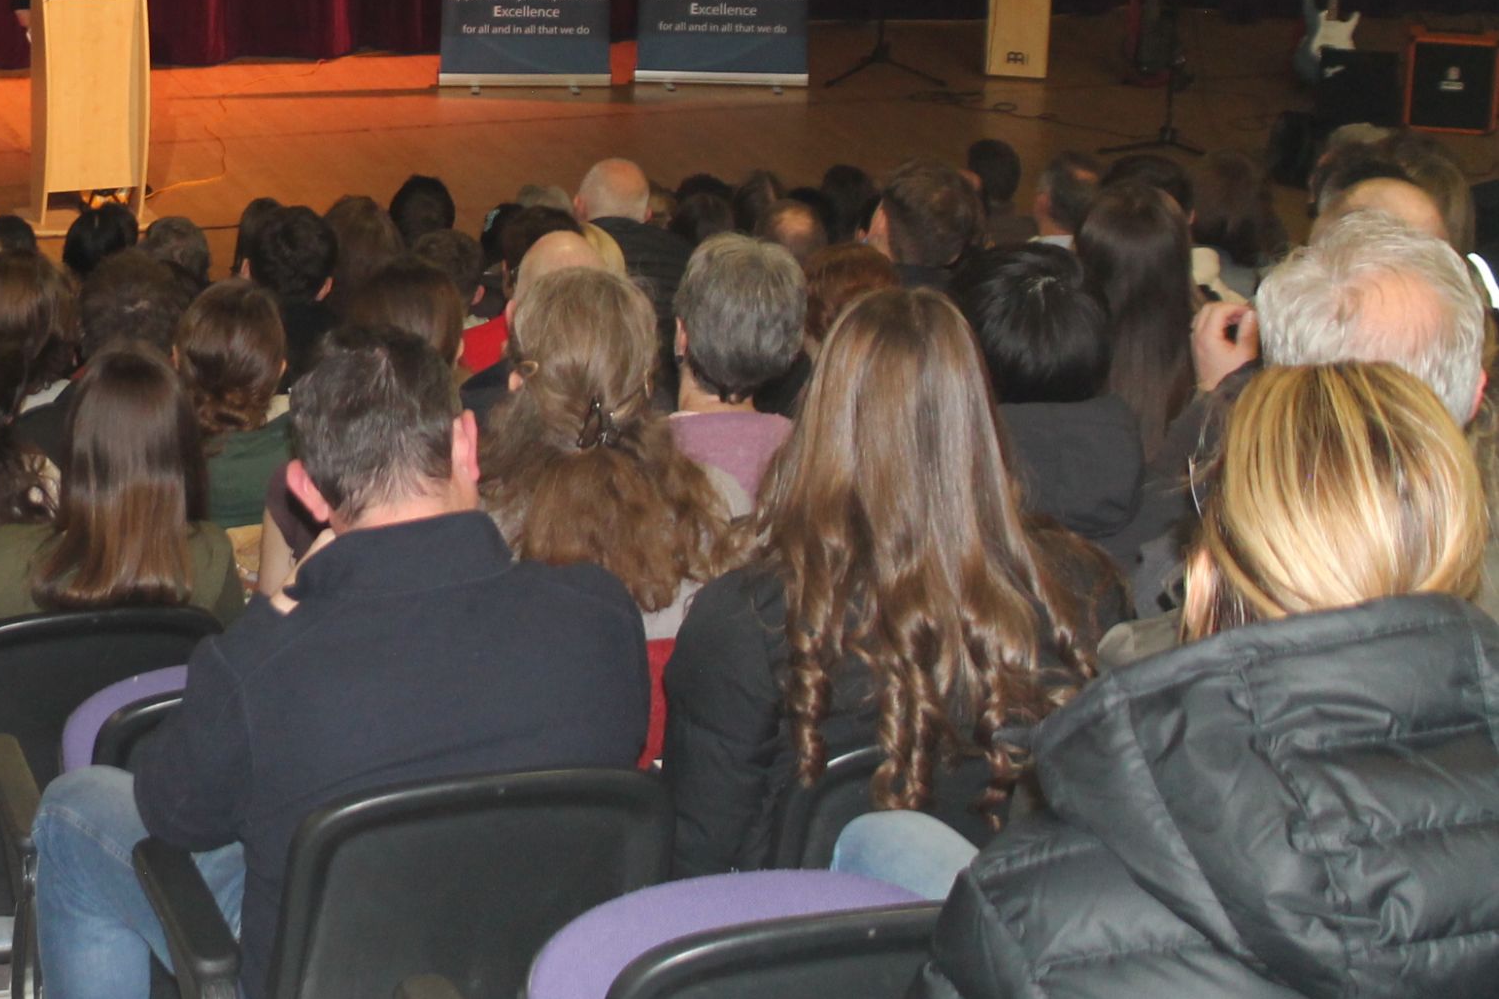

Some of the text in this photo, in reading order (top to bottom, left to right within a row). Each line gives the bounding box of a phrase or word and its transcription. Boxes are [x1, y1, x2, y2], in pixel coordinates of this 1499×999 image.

[493, 5, 560, 18] Excellence
[690, 2, 757, 16] Excellence
[462, 24, 590, 35] for all and in all that we do
[658, 21, 787, 34] for all and in all that we do
